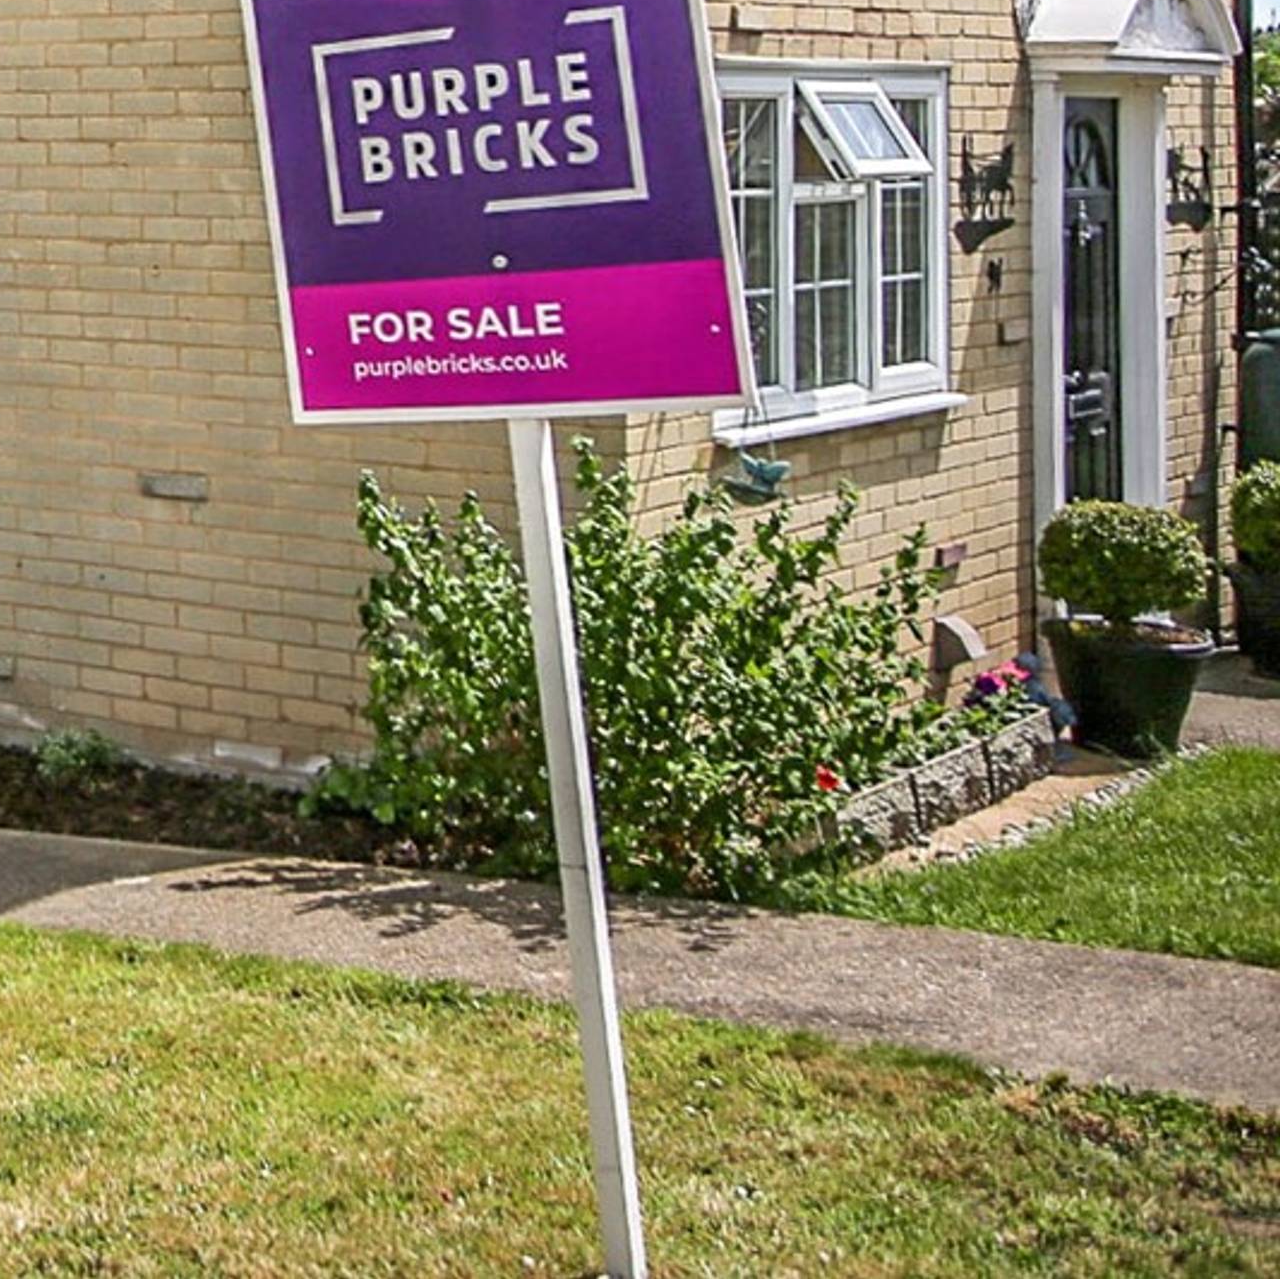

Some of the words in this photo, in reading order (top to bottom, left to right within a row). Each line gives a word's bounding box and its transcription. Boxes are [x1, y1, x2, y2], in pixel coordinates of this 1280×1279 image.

[351, 51, 592, 125] PURPLE
[359, 114, 599, 183] BRICKS
[348, 310, 435, 345] FOR
[447, 302, 565, 340] SALE
[353, 349, 568, 381] purplebricks.co.uk
